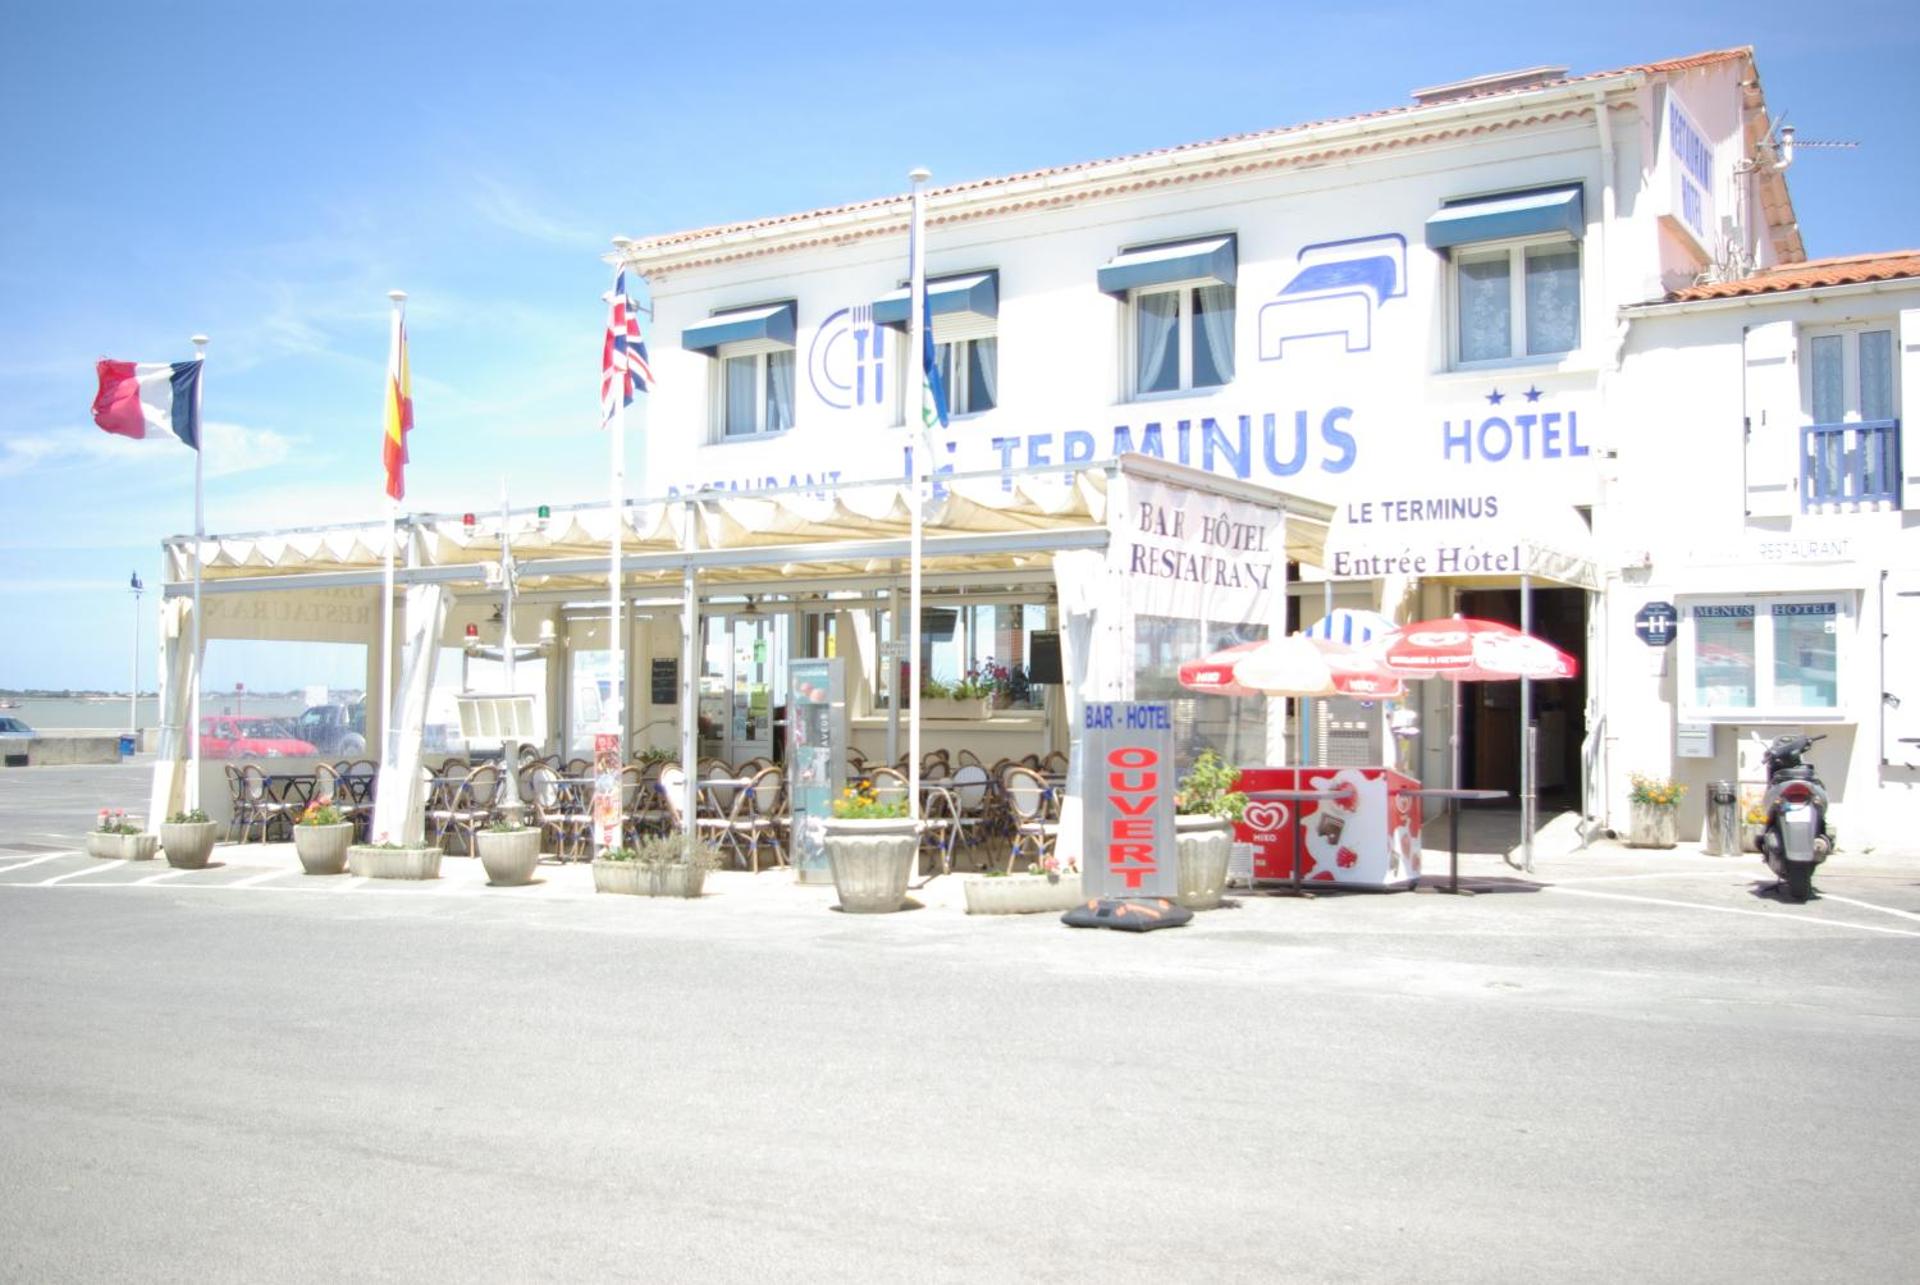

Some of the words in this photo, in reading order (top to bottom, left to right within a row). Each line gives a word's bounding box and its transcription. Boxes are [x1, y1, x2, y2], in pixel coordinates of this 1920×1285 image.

[992, 406, 1357, 492] TERMINUS
[1443, 411, 1589, 464] HOTEL
[1348, 503, 1373, 524] LE
[1381, 496, 1499, 523] TERMINUS
[1139, 501, 1185, 540] BAR
[1200, 511, 1270, 552] HÔTEL
[1333, 548, 1427, 577] Entrée
[1437, 544, 1522, 575] Hôtel
[1697, 605, 1755, 617] MENUS
[1774, 603, 1834, 616] HOTEL
[1649, 616, 1665, 634] H
[1085, 705, 1114, 729] BAR
[1127, 705, 1170, 730] HOTEL
[1107, 746, 1159, 888] OUVERT
